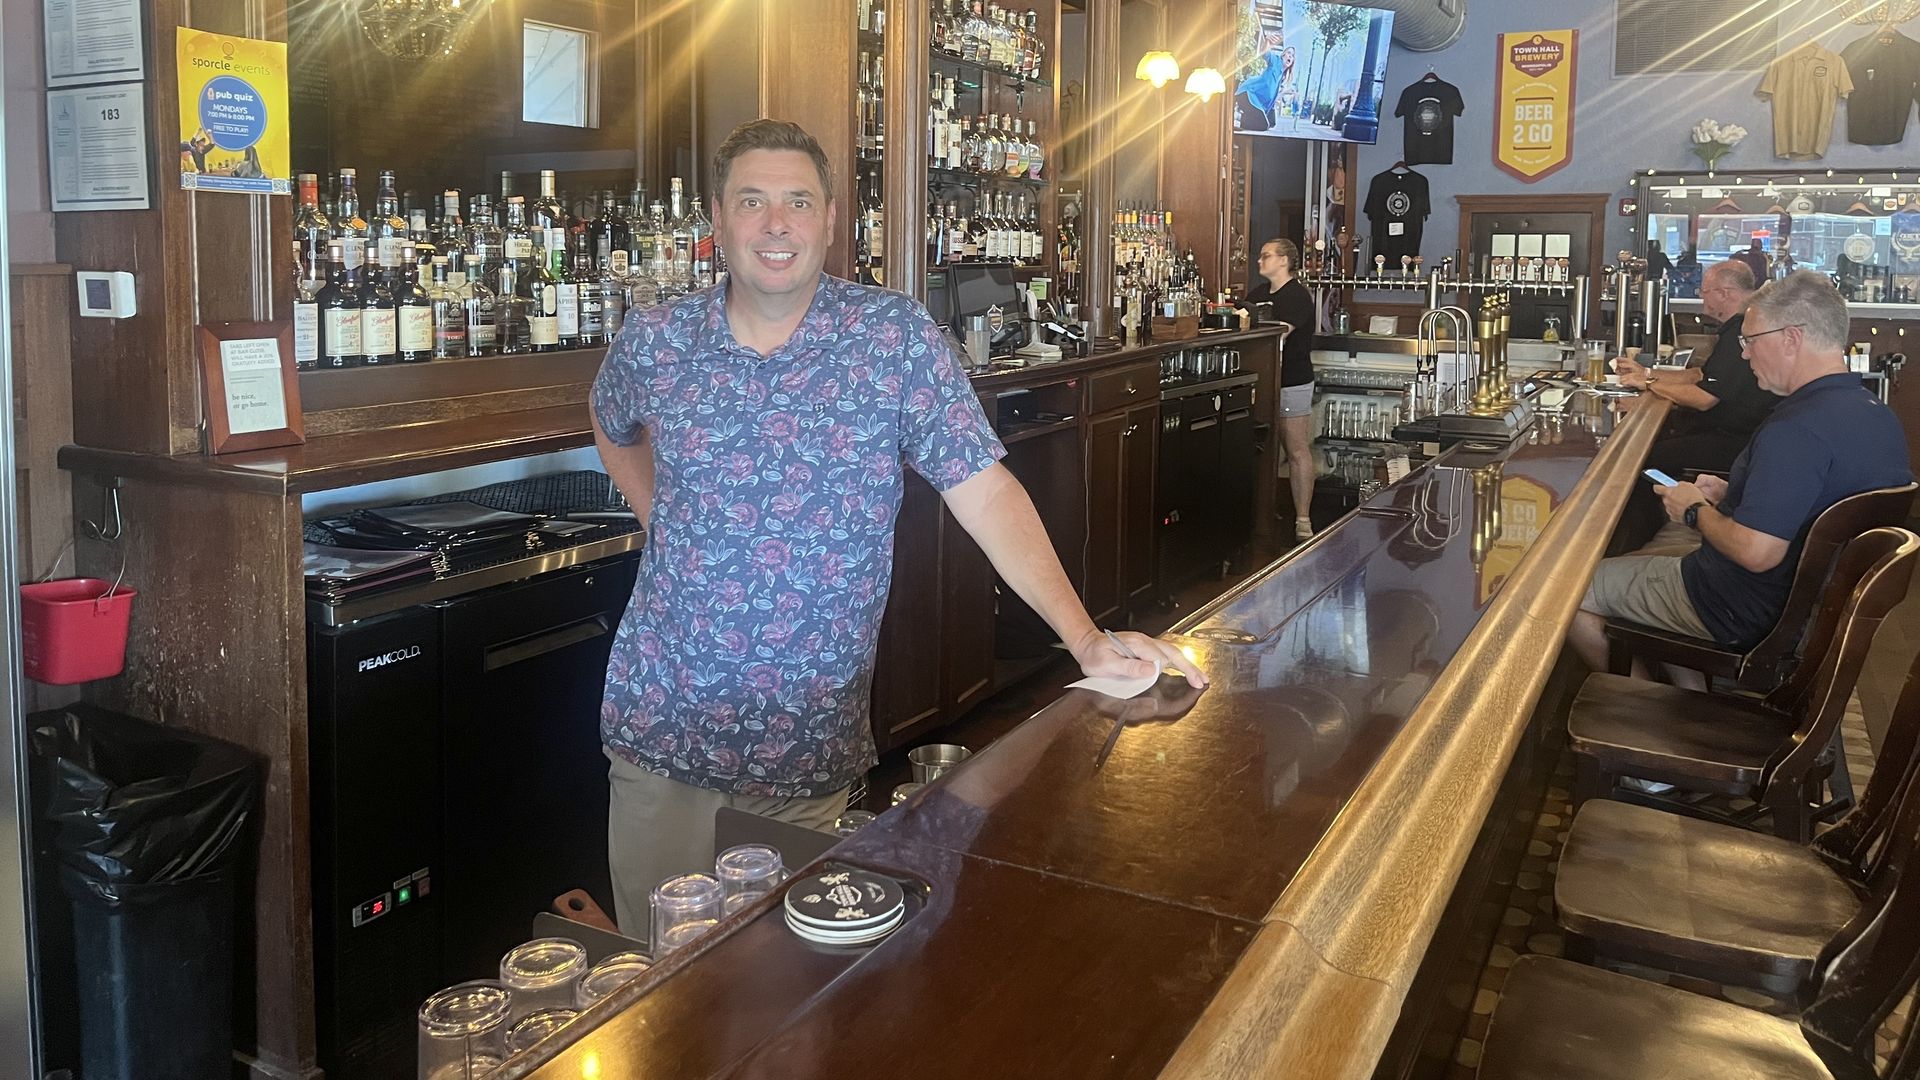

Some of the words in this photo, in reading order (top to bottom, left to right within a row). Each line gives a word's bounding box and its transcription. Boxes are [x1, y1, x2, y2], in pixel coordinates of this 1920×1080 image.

[1539, 45, 1560, 53] HALL
[1515, 53, 1560, 62] BREWERY
[192, 57, 231, 71] sporcle
[233, 63, 271, 76] events
[216, 91, 232, 100] pub
[234, 93, 254, 102] quiz
[212, 103, 248, 114] MONDAYS
[1515, 104, 1553, 121] BEER
[101, 108, 120, 121] 183
[1513, 124, 1524, 144] 2
[1528, 123, 1553, 144] GO
[241, 392, 256, 400] nice,
